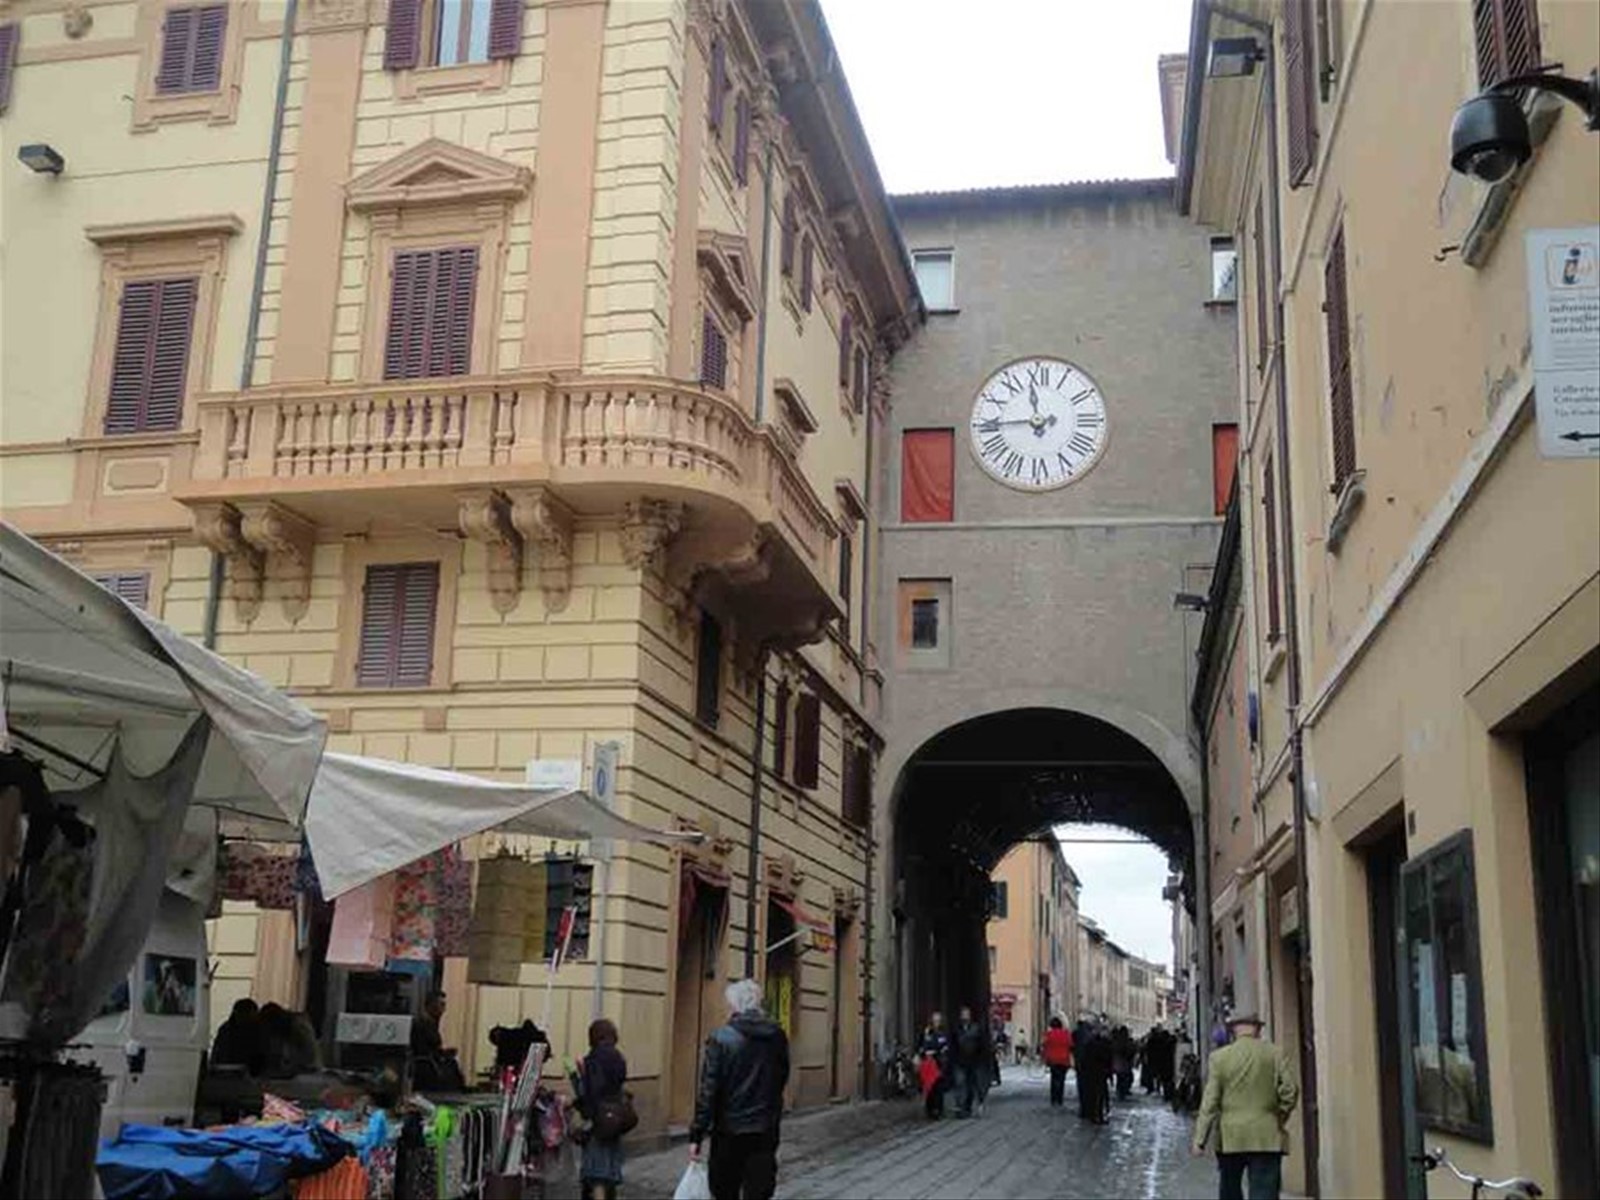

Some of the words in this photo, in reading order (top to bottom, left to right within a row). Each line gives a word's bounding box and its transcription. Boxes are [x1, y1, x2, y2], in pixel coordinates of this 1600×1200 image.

[1026, 366, 1050, 387] XII
[1070, 388, 1091, 406] II
[1076, 413, 1098, 428] III
